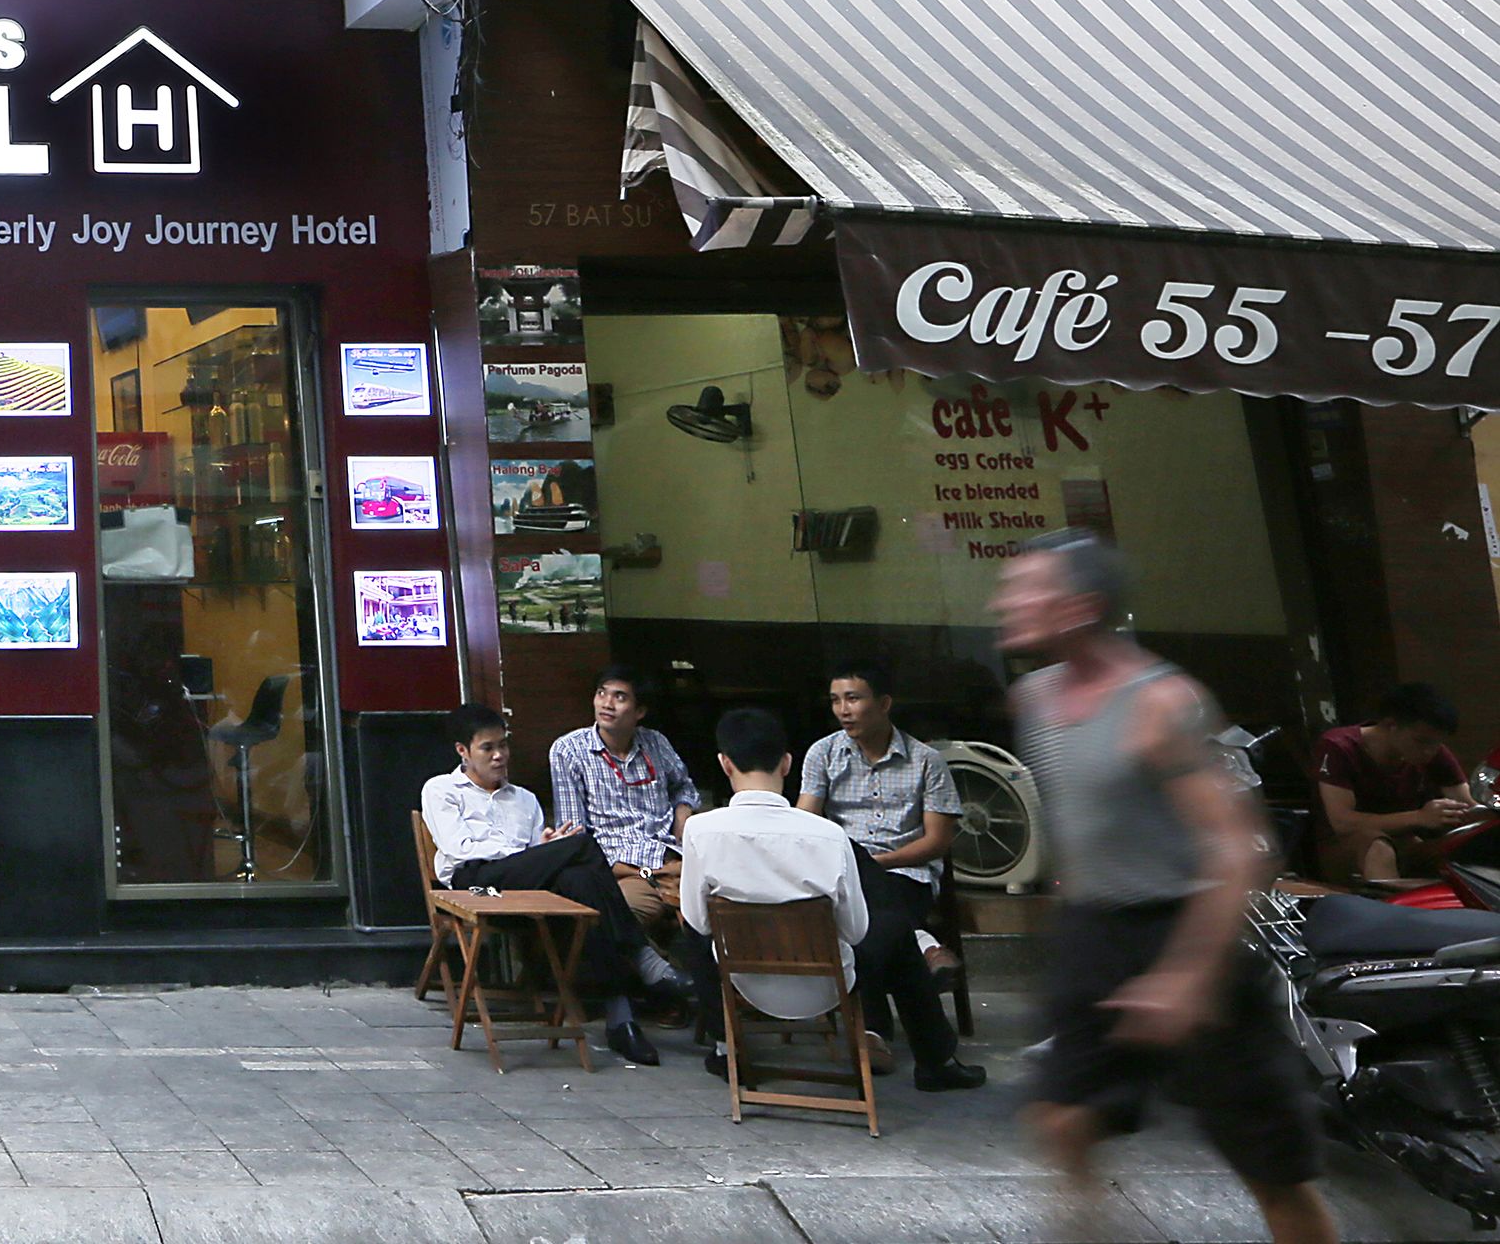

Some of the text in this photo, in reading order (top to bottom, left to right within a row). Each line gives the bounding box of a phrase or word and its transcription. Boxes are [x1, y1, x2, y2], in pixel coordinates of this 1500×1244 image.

[529, 204, 556, 226] 57
[567, 204, 612, 227] BAT
[72, 213, 132, 253] Joy
[144, 214, 278, 253] Journey
[291, 214, 377, 245] Hotel
[895, 261, 1120, 363] Café
[1139, 281, 1288, 366] 55
[487, 365, 583, 378] Perfume Pagoda
[932, 383, 1013, 439] cafe
[492, 464, 535, 477] Halong
[935, 453, 1035, 470] egg Coffee
[935, 483, 1040, 501] Ice blended
[943, 512, 1046, 530] Milk Shake
[500, 558, 541, 573] SaPa
